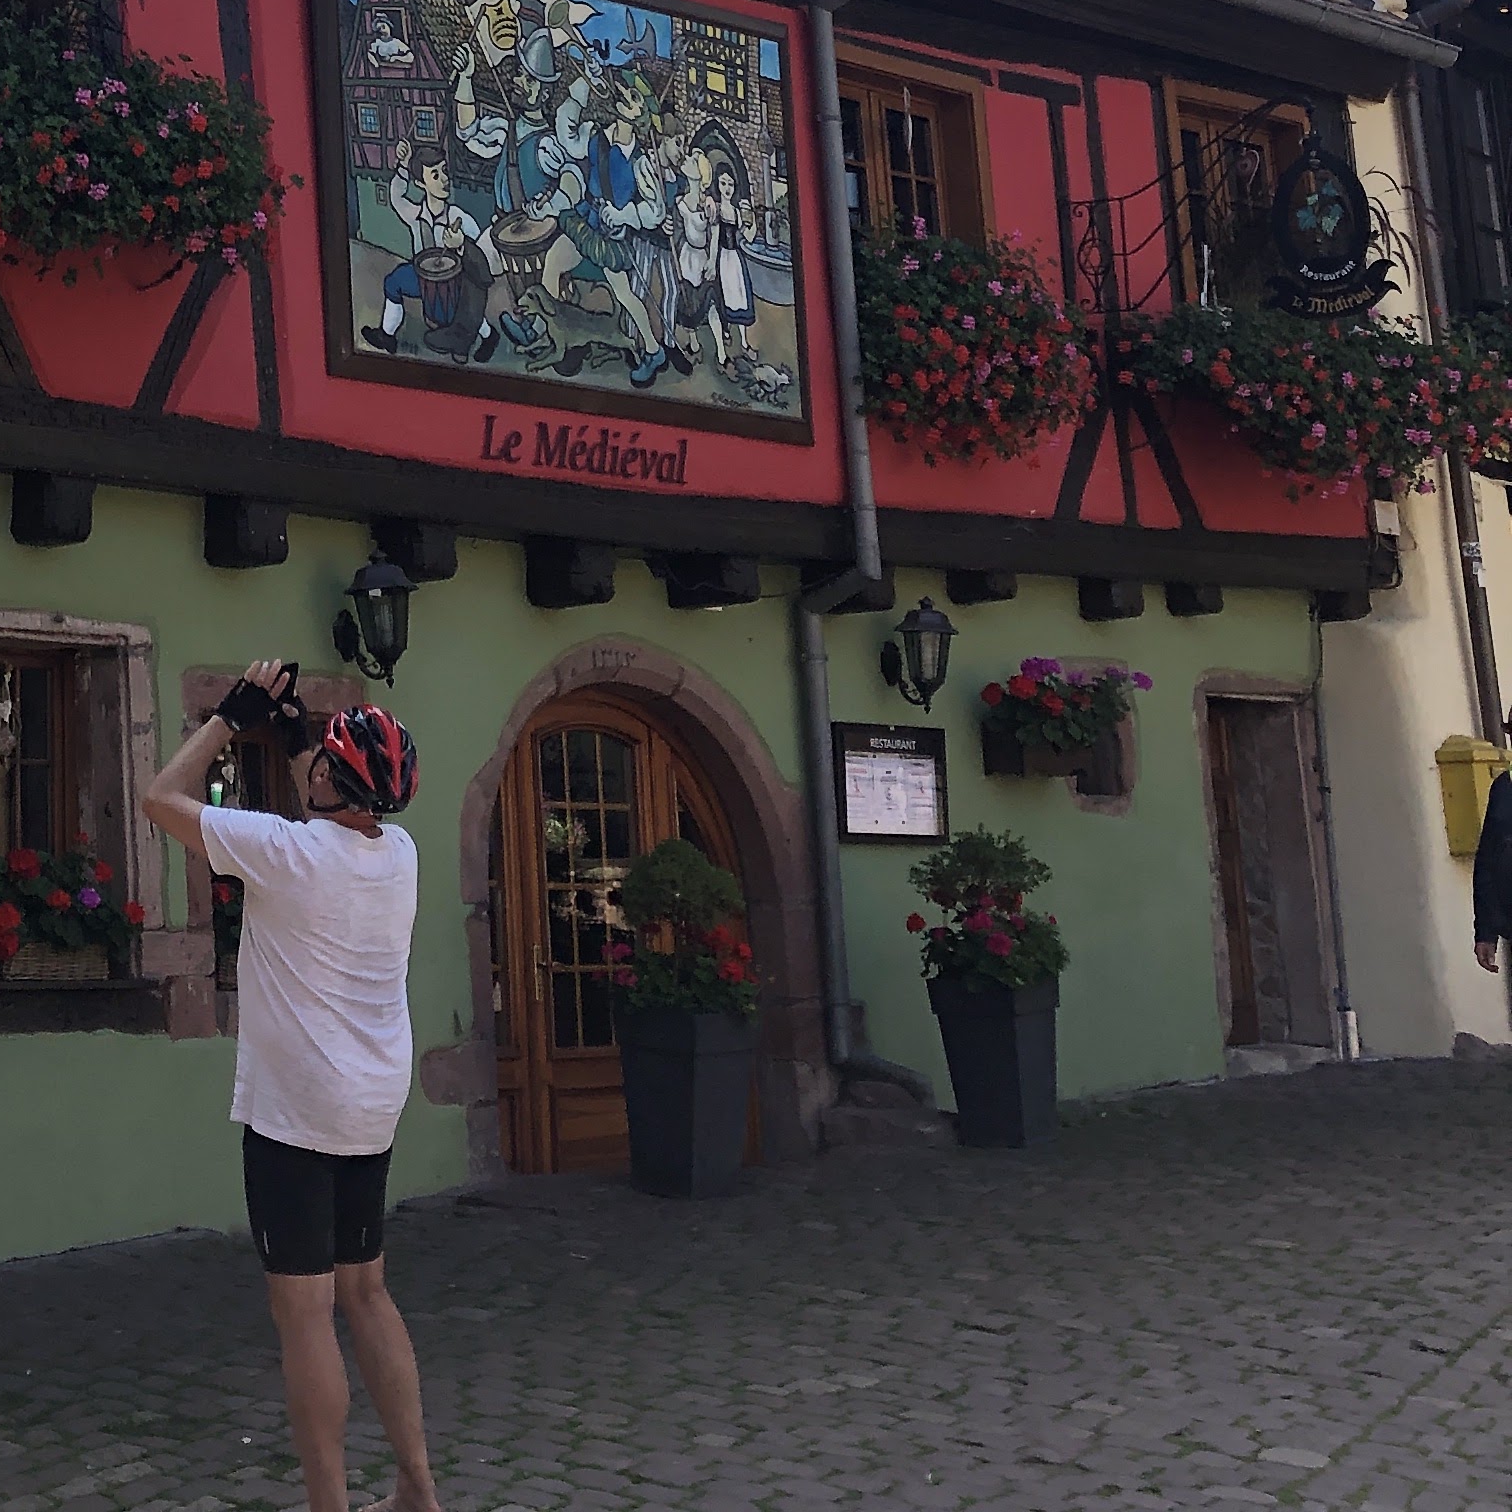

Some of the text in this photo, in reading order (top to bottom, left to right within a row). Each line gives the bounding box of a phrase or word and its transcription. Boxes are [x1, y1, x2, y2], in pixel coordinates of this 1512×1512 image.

[1299, 260, 1356, 281] Restaurant
[480, 414, 688, 485] Le Médiéval
[870, 738, 916, 750] RESTAURANT
